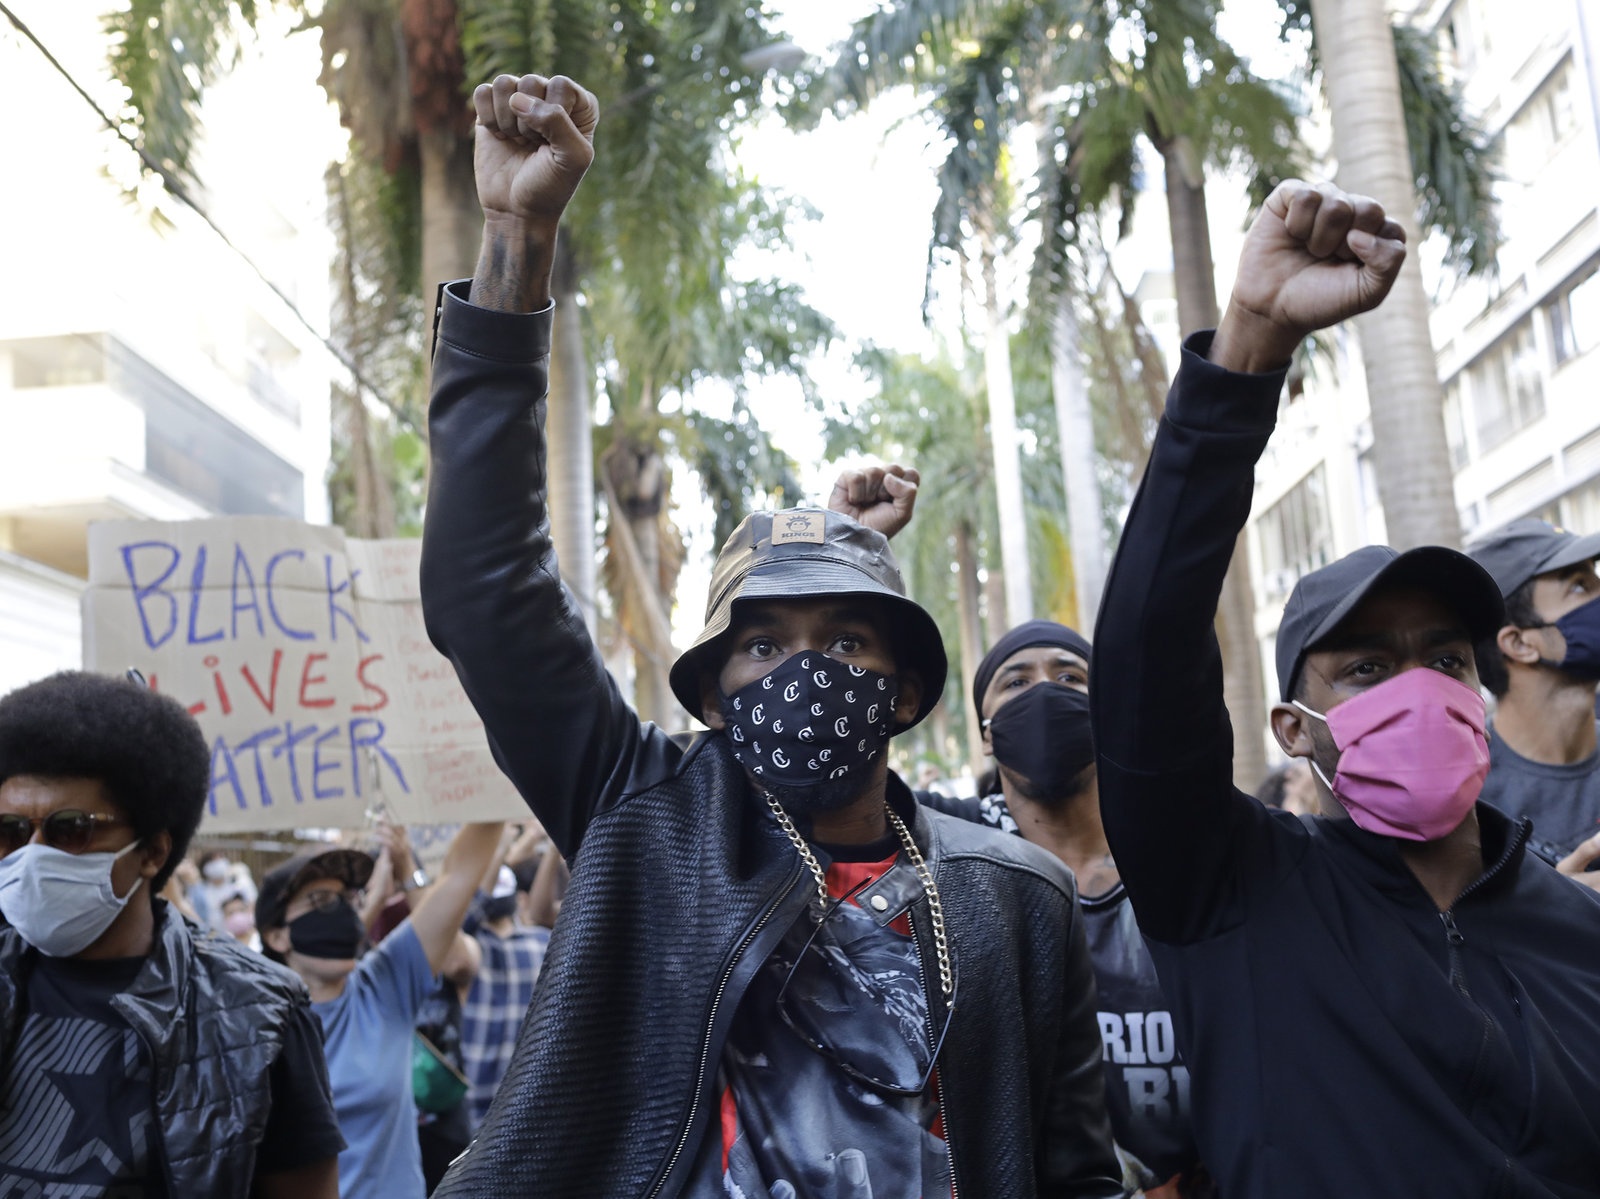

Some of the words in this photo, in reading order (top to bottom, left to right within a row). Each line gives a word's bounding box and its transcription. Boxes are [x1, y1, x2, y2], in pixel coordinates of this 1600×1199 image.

[119, 541, 370, 650] BLACK
[208, 717, 411, 816] ATTER
[1096, 1010, 1183, 1065] RIO
